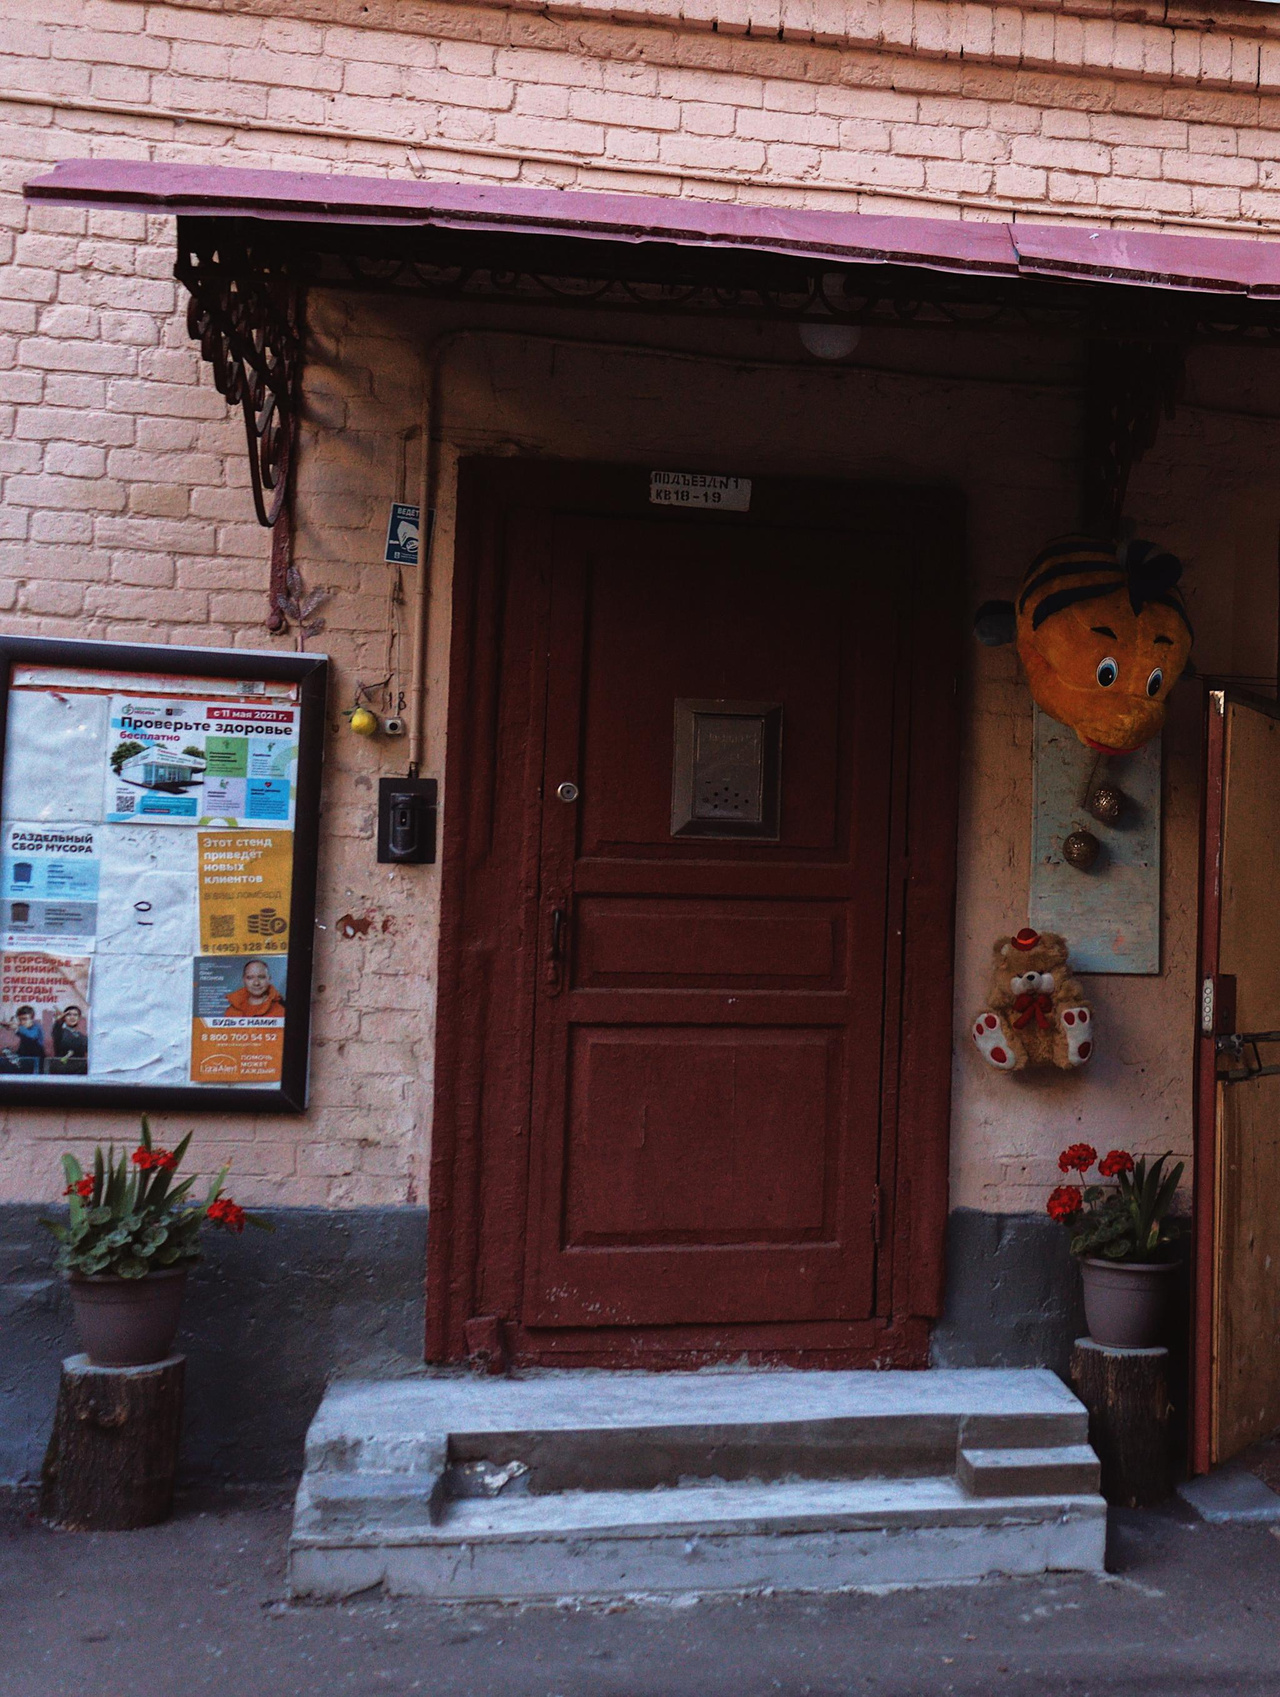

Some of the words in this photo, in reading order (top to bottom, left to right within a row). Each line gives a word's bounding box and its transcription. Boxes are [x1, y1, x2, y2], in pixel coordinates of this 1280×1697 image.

[222, 710, 231, 718] 11
[232, 711, 252, 719] мая
[254, 711, 277, 720] 2021
[121, 716, 211, 733] Проверьте
[215, 722, 293, 736] здоровье
[119, 730, 181, 742] бесплатно
[12, 832, 94, 844] РАЗДЕЛЬНЫЙ
[203, 837, 233, 848] Этот
[235, 838, 273, 848] стенд
[12, 842, 43, 851] СБОР
[45, 844, 93, 854] МУСОРА
[203, 863, 245, 872] новых
[204, 875, 264, 885] клиентов
[2, 985, 53, 994] ОТХОДЫ
[211, 1018, 237, 1027] БУДЬ
[238, 1018, 245, 1026] С
[201, 1033, 208, 1041] 8
[209, 1033, 228, 1041] 800
[230, 1033, 249, 1041] 700
[264, 1032, 278, 1041] 52
